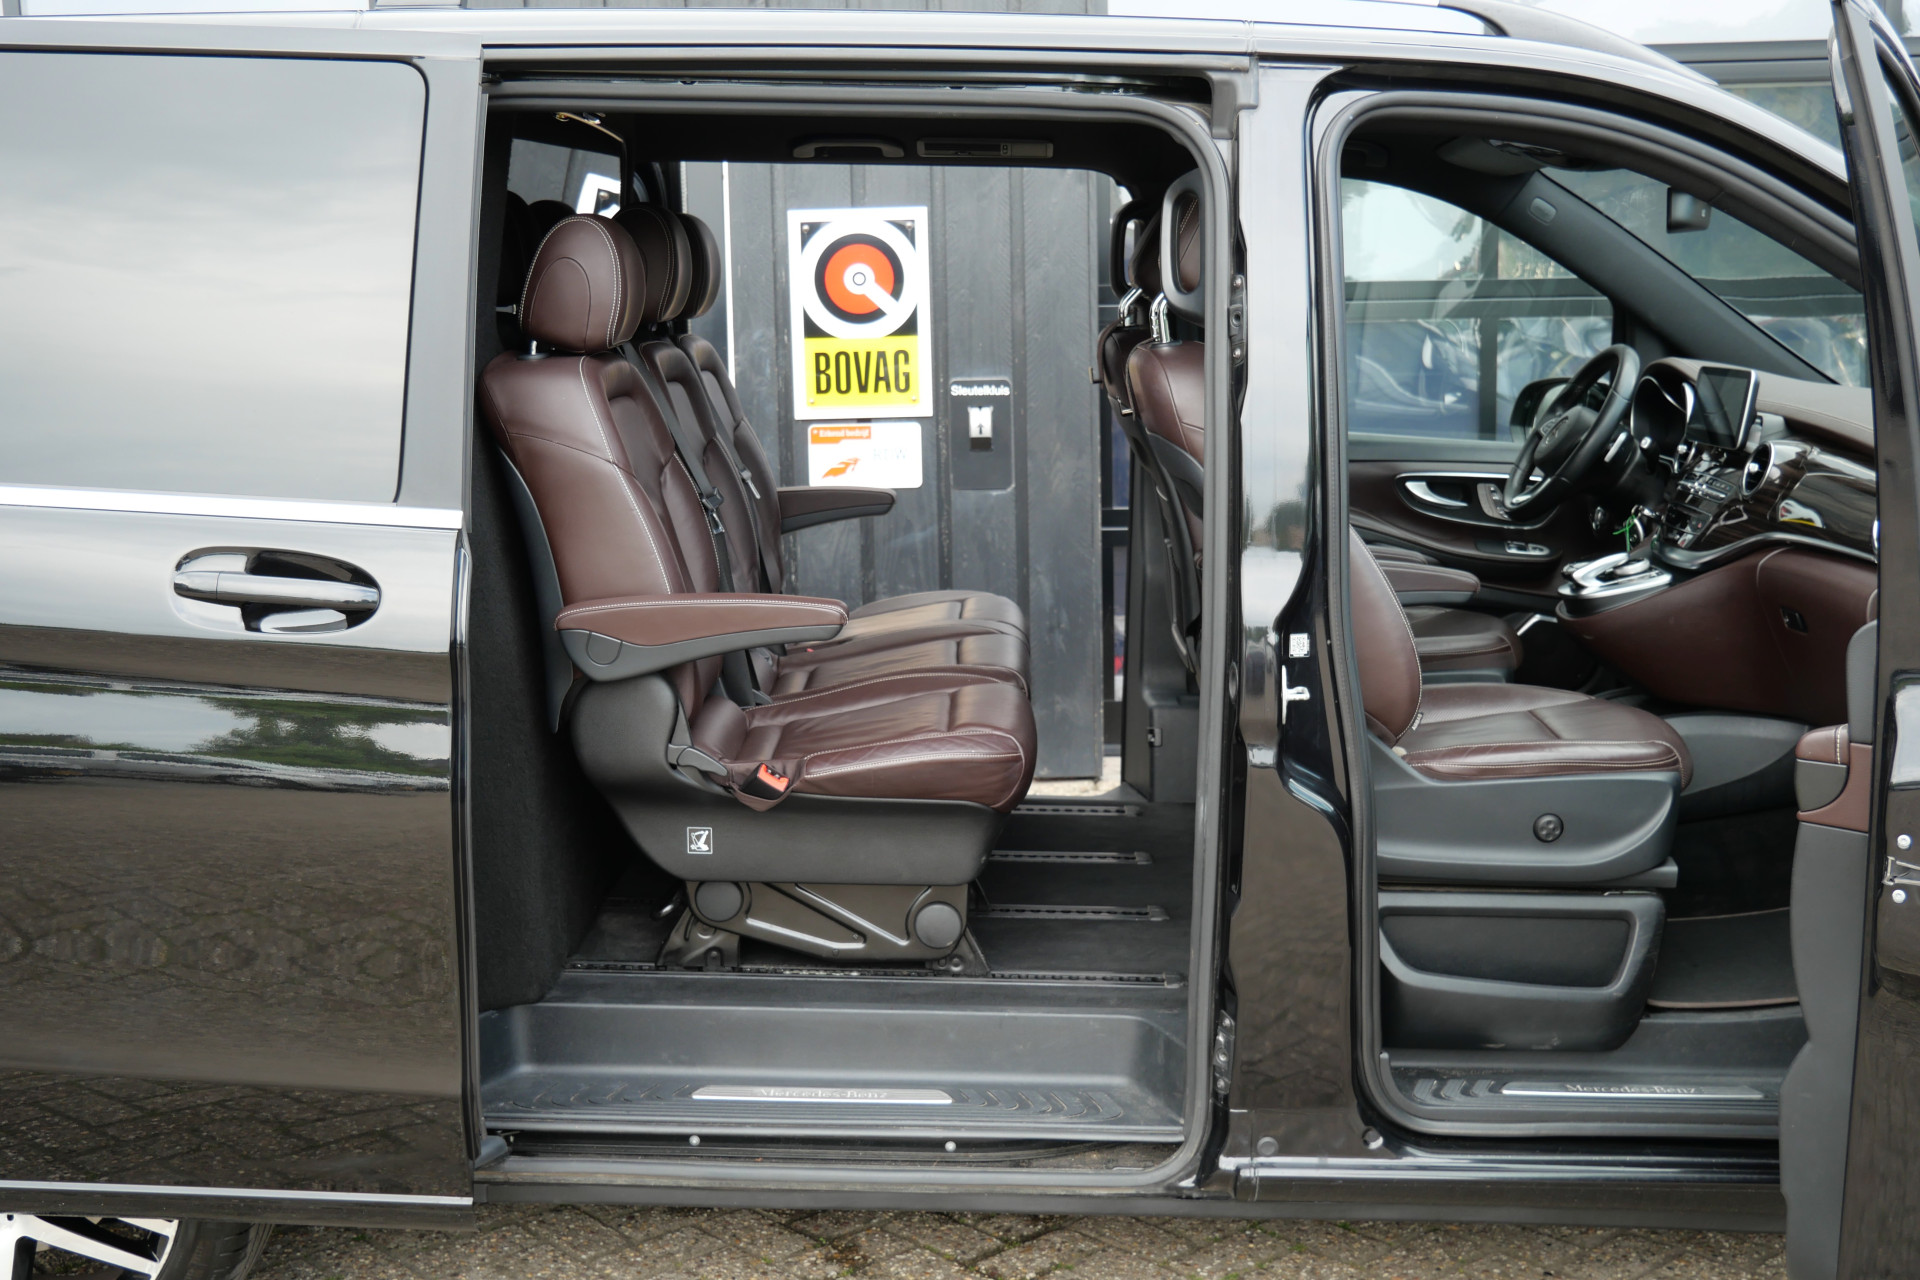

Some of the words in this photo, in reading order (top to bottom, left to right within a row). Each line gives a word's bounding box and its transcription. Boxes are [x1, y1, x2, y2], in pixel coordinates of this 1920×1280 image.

[814, 349, 910, 394] BOVAG
[950, 384, 1010, 396] Sleutelkluis
[760, 1088, 887, 1098] Mercedes-Benz
[1564, 1083, 1696, 1094] Mercedes-Benz
